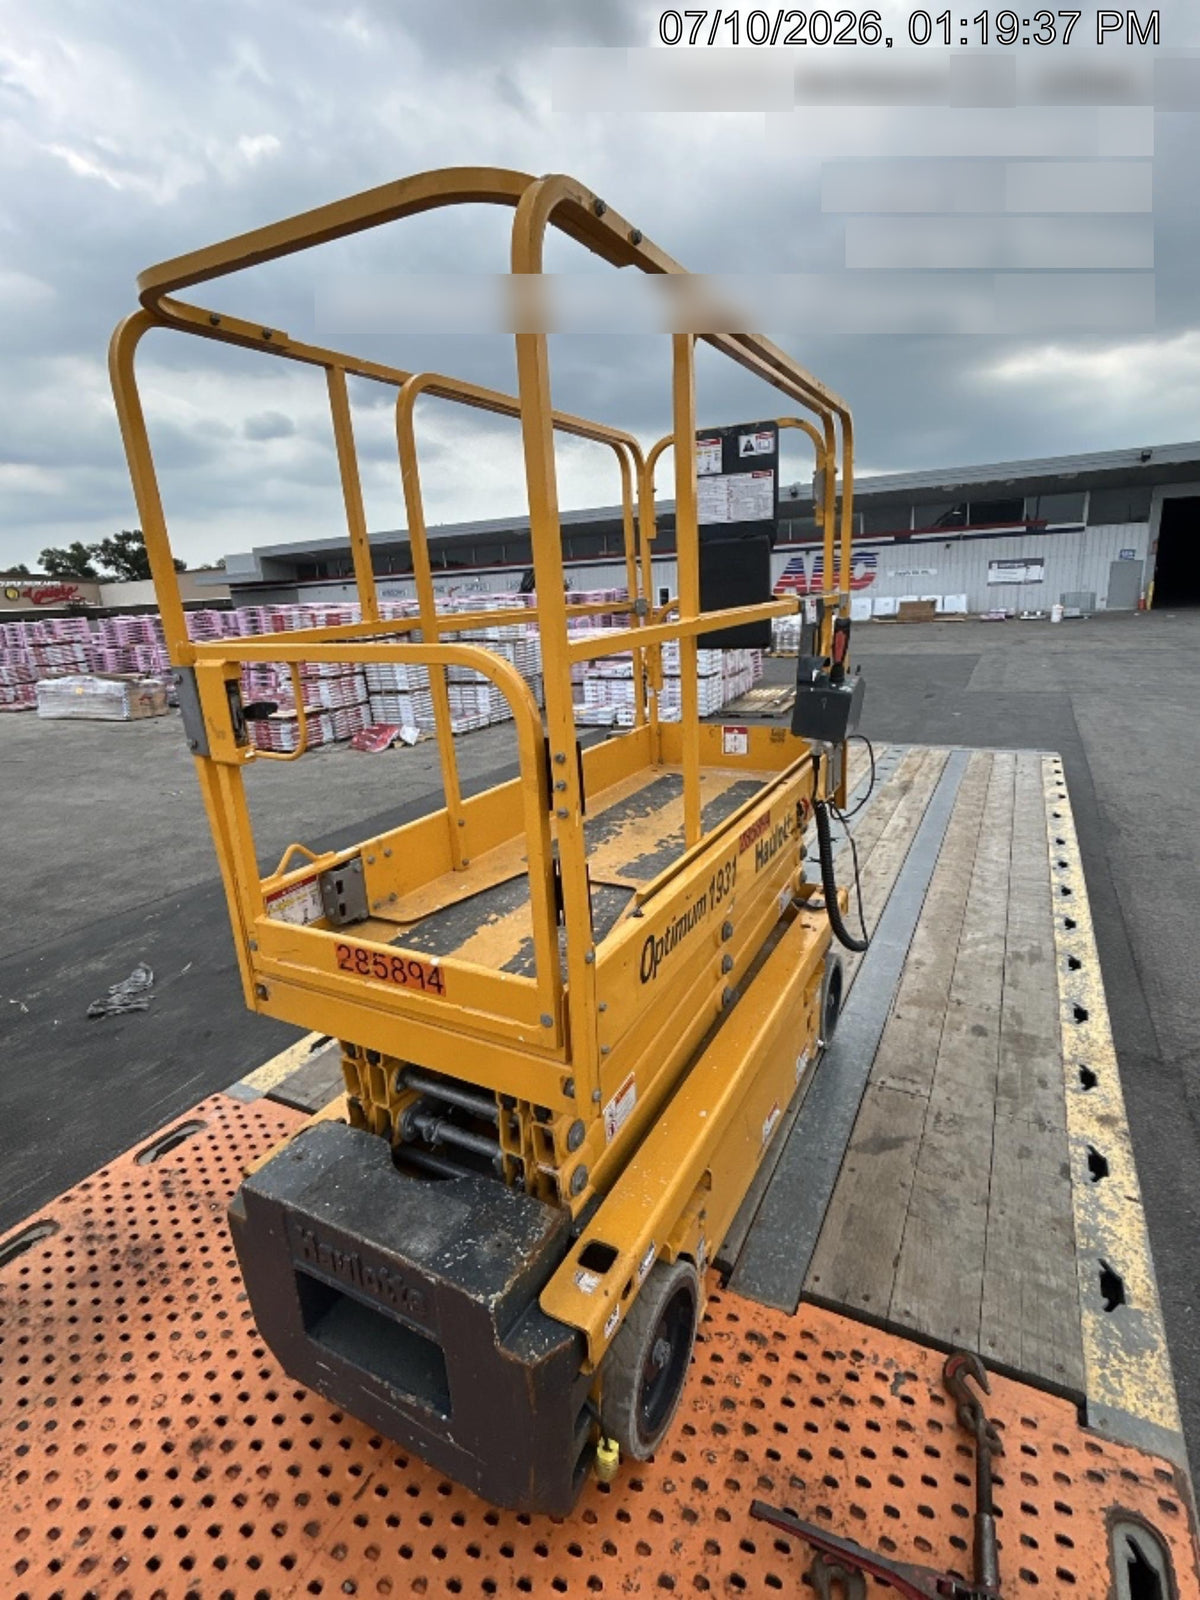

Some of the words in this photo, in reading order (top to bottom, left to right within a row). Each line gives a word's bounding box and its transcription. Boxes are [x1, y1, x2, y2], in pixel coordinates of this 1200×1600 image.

[640, 893, 706, 984] Optimum
[709, 855, 737, 911] 1931
[337, 944, 444, 995] 285894
